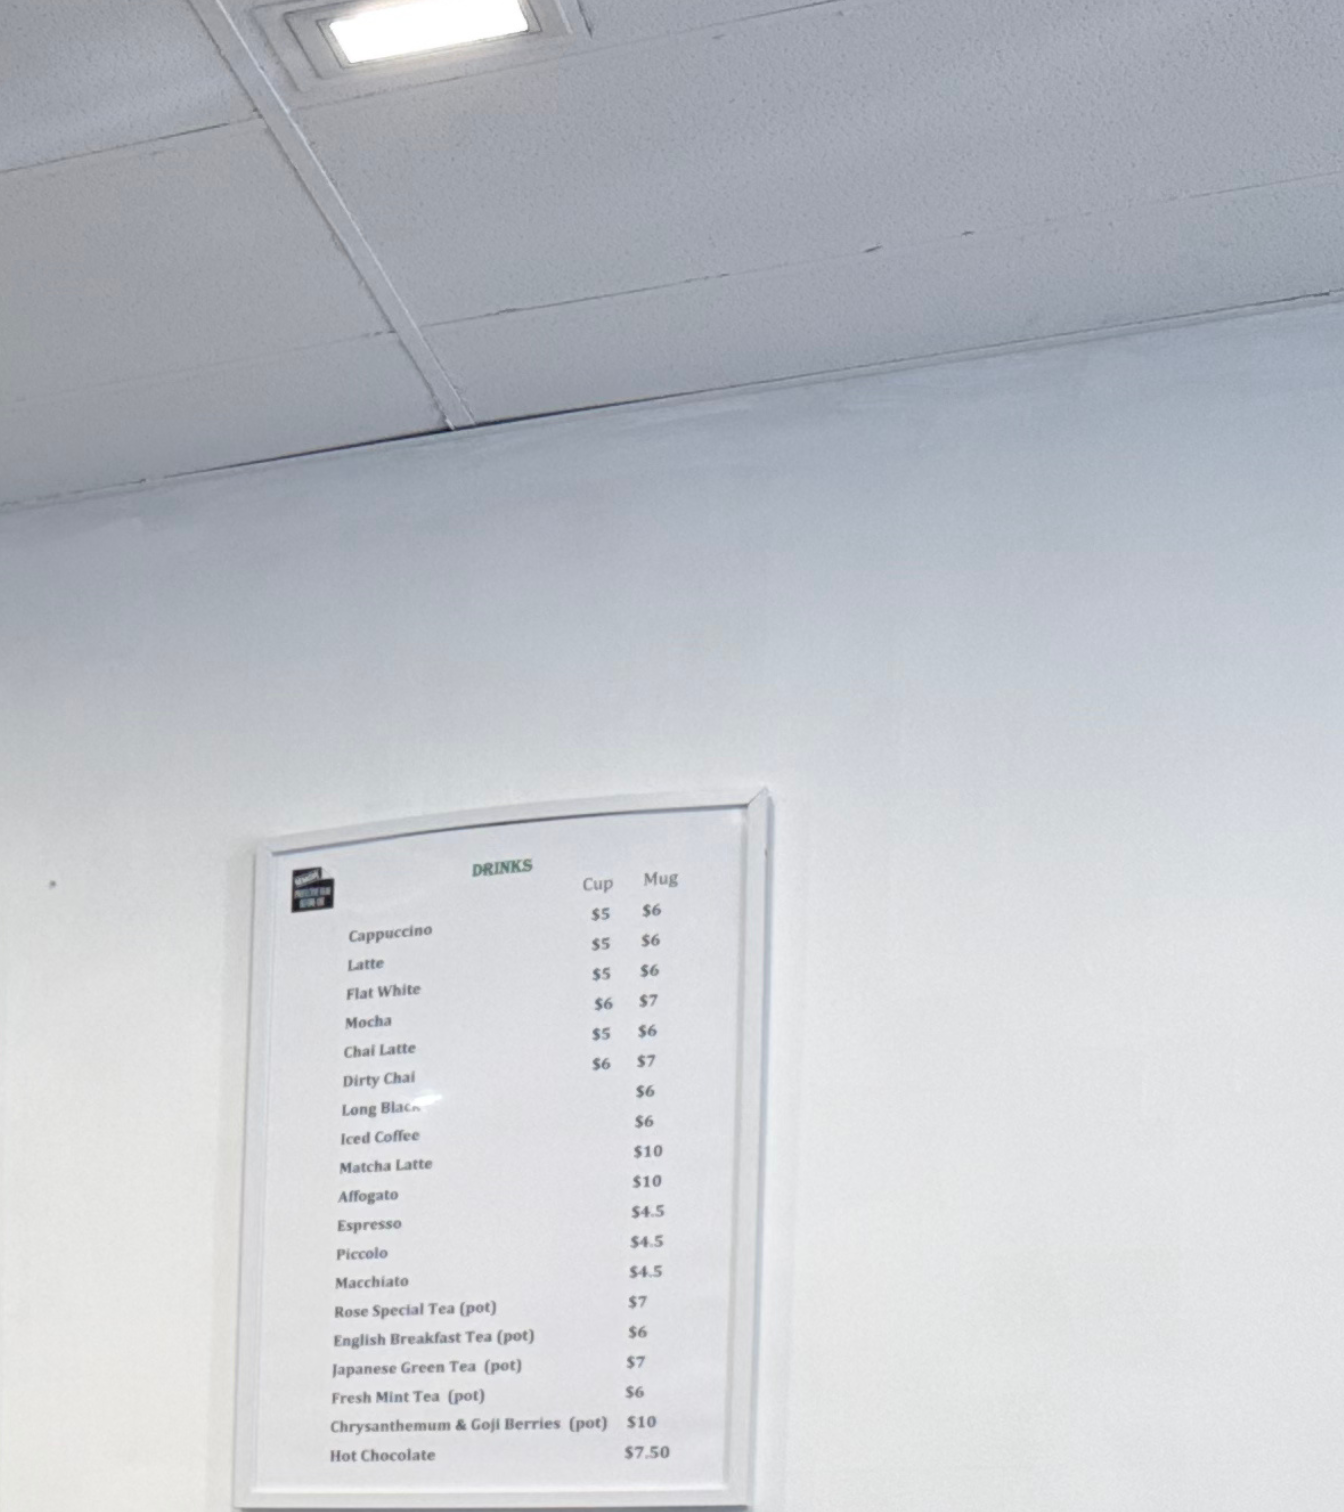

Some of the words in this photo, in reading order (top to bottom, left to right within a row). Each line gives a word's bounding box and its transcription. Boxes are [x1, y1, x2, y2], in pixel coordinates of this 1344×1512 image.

[472, 859, 533, 876] DRINKS
[583, 876, 612, 893] Cup
[644, 871, 678, 888] Mug
[349, 924, 432, 943] Cappuccino
[591, 907, 610, 922] $5
[642, 903, 661, 917] $6
[348, 957, 384, 971] Latte
[592, 937, 610, 951] $5
[641, 933, 660, 948] $6
[346, 987, 373, 1001] Flat
[377, 983, 421, 998] White
[592, 967, 611, 981] $5
[640, 963, 659, 977] $6
[345, 1015, 392, 1029] Mocha
[594, 996, 612, 1011] $6
[639, 994, 658, 1008] $7
[343, 1075, 380, 1090] Dirty
[384, 1072, 415, 1085] Chai
[592, 1056, 611, 1071] $6
[637, 1054, 655, 1068] $7
[342, 1104, 376, 1118] Long
[636, 1084, 654, 1098] $6
[338, 1188, 398, 1205] Affogato
[632, 1174, 661, 1189] $10
[337, 1218, 401, 1234] Espresso
[631, 1204, 664, 1219] $4.5
[334, 1306, 368, 1318] Rose
[372, 1302, 423, 1318] Special
[428, 1302, 455, 1316] Tea
[459, 1301, 497, 1317] (pot)
[628, 1295, 647, 1310] $7
[334, 1332, 386, 1349] English
[390, 1331, 460, 1346] Breakfast
[465, 1331, 492, 1344] Tea
[496, 1329, 535, 1345] (pot)
[628, 1325, 647, 1340] $6
[330, 1419, 451, 1435] Chrysanthemum
[456, 1419, 467, 1432] &
[471, 1418, 500, 1433] Goji
[505, 1417, 560, 1431] Berries
[569, 1416, 608, 1432] (pot)
[627, 1415, 656, 1430] $10
[330, 1449, 357, 1462] Hot
[361, 1448, 435, 1462] Chocolate
[624, 1445, 670, 1460] $7.50
